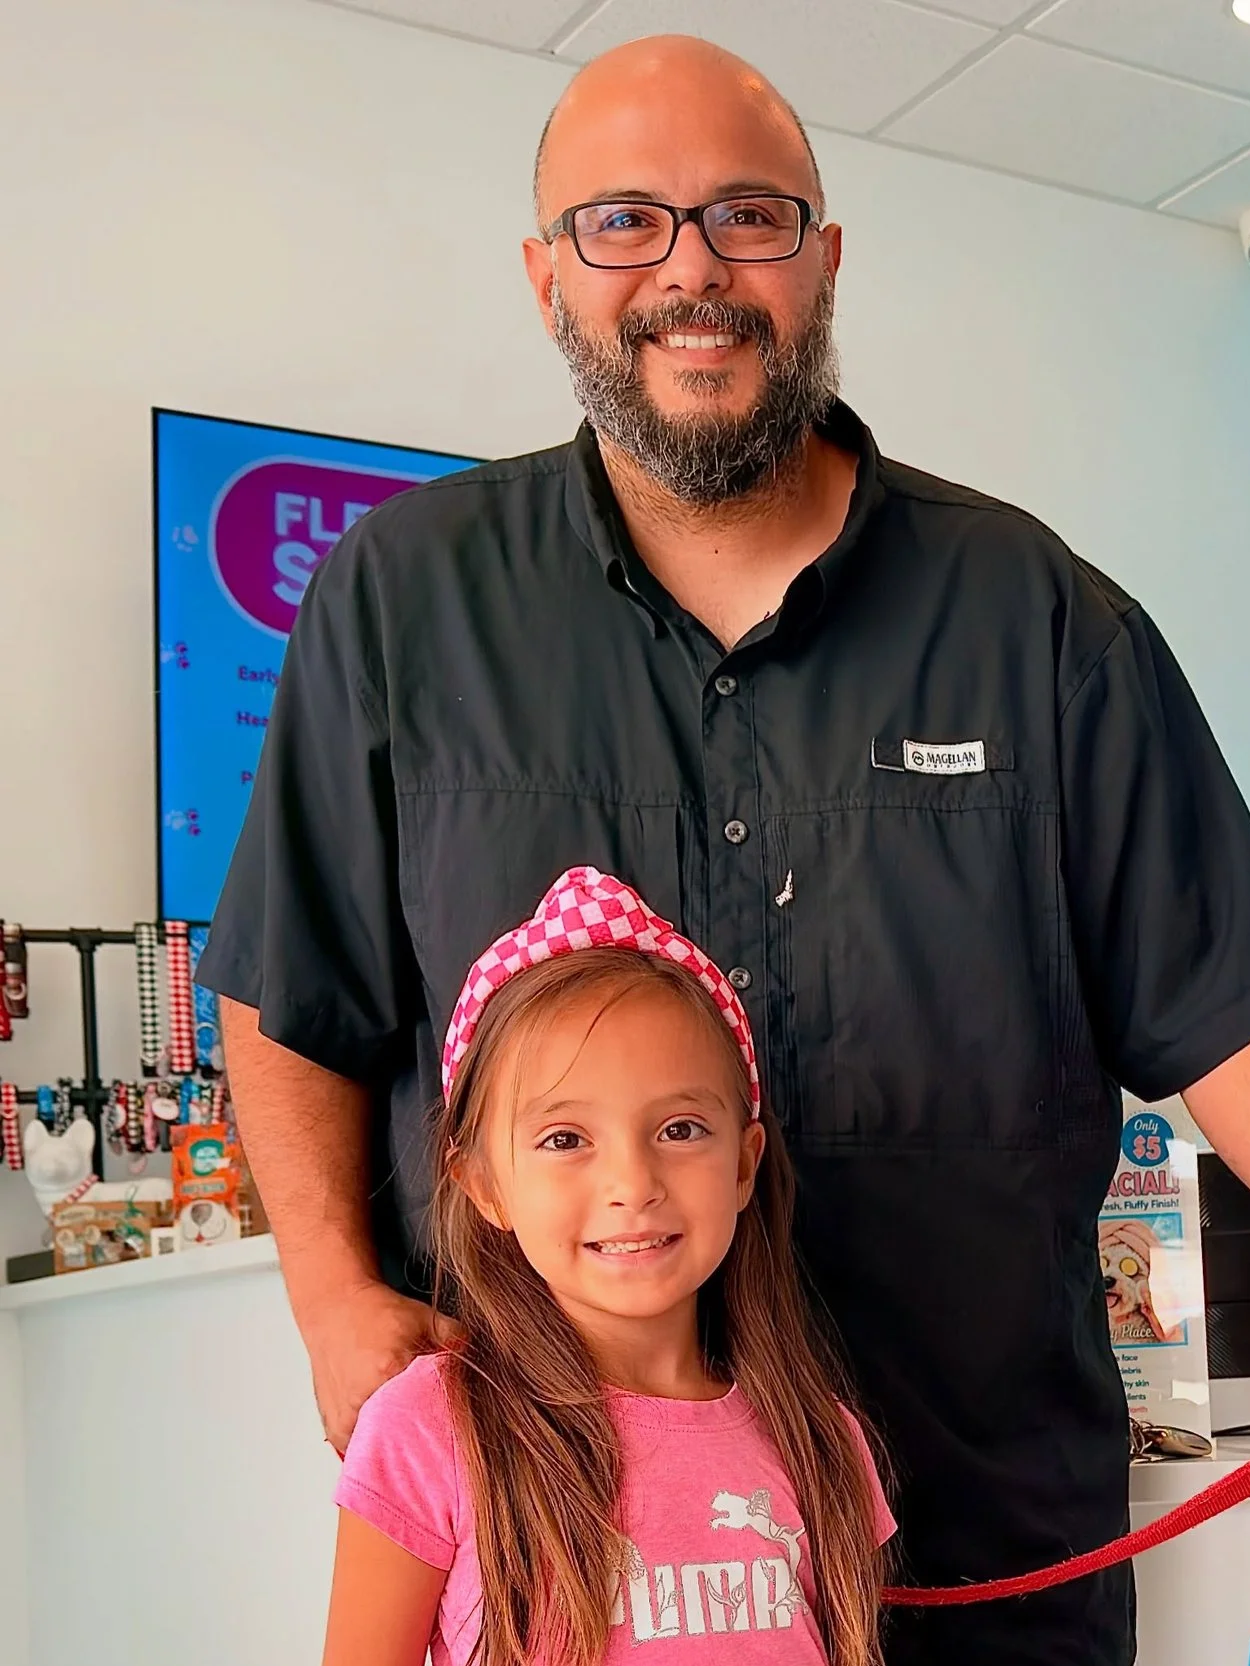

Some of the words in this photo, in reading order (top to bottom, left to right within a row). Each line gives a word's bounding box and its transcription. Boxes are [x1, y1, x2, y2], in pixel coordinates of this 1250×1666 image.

[239, 665, 280, 687] Early
[926, 751, 977, 764] MAGELLAN
[1134, 1119, 1159, 1134] Only
[1133, 1134, 1161, 1160] $5
[1106, 1170, 1180, 1197] ACIAL!
[1124, 1199, 1149, 1211] Fluffy
[1151, 1198, 1180, 1208] Finish!
